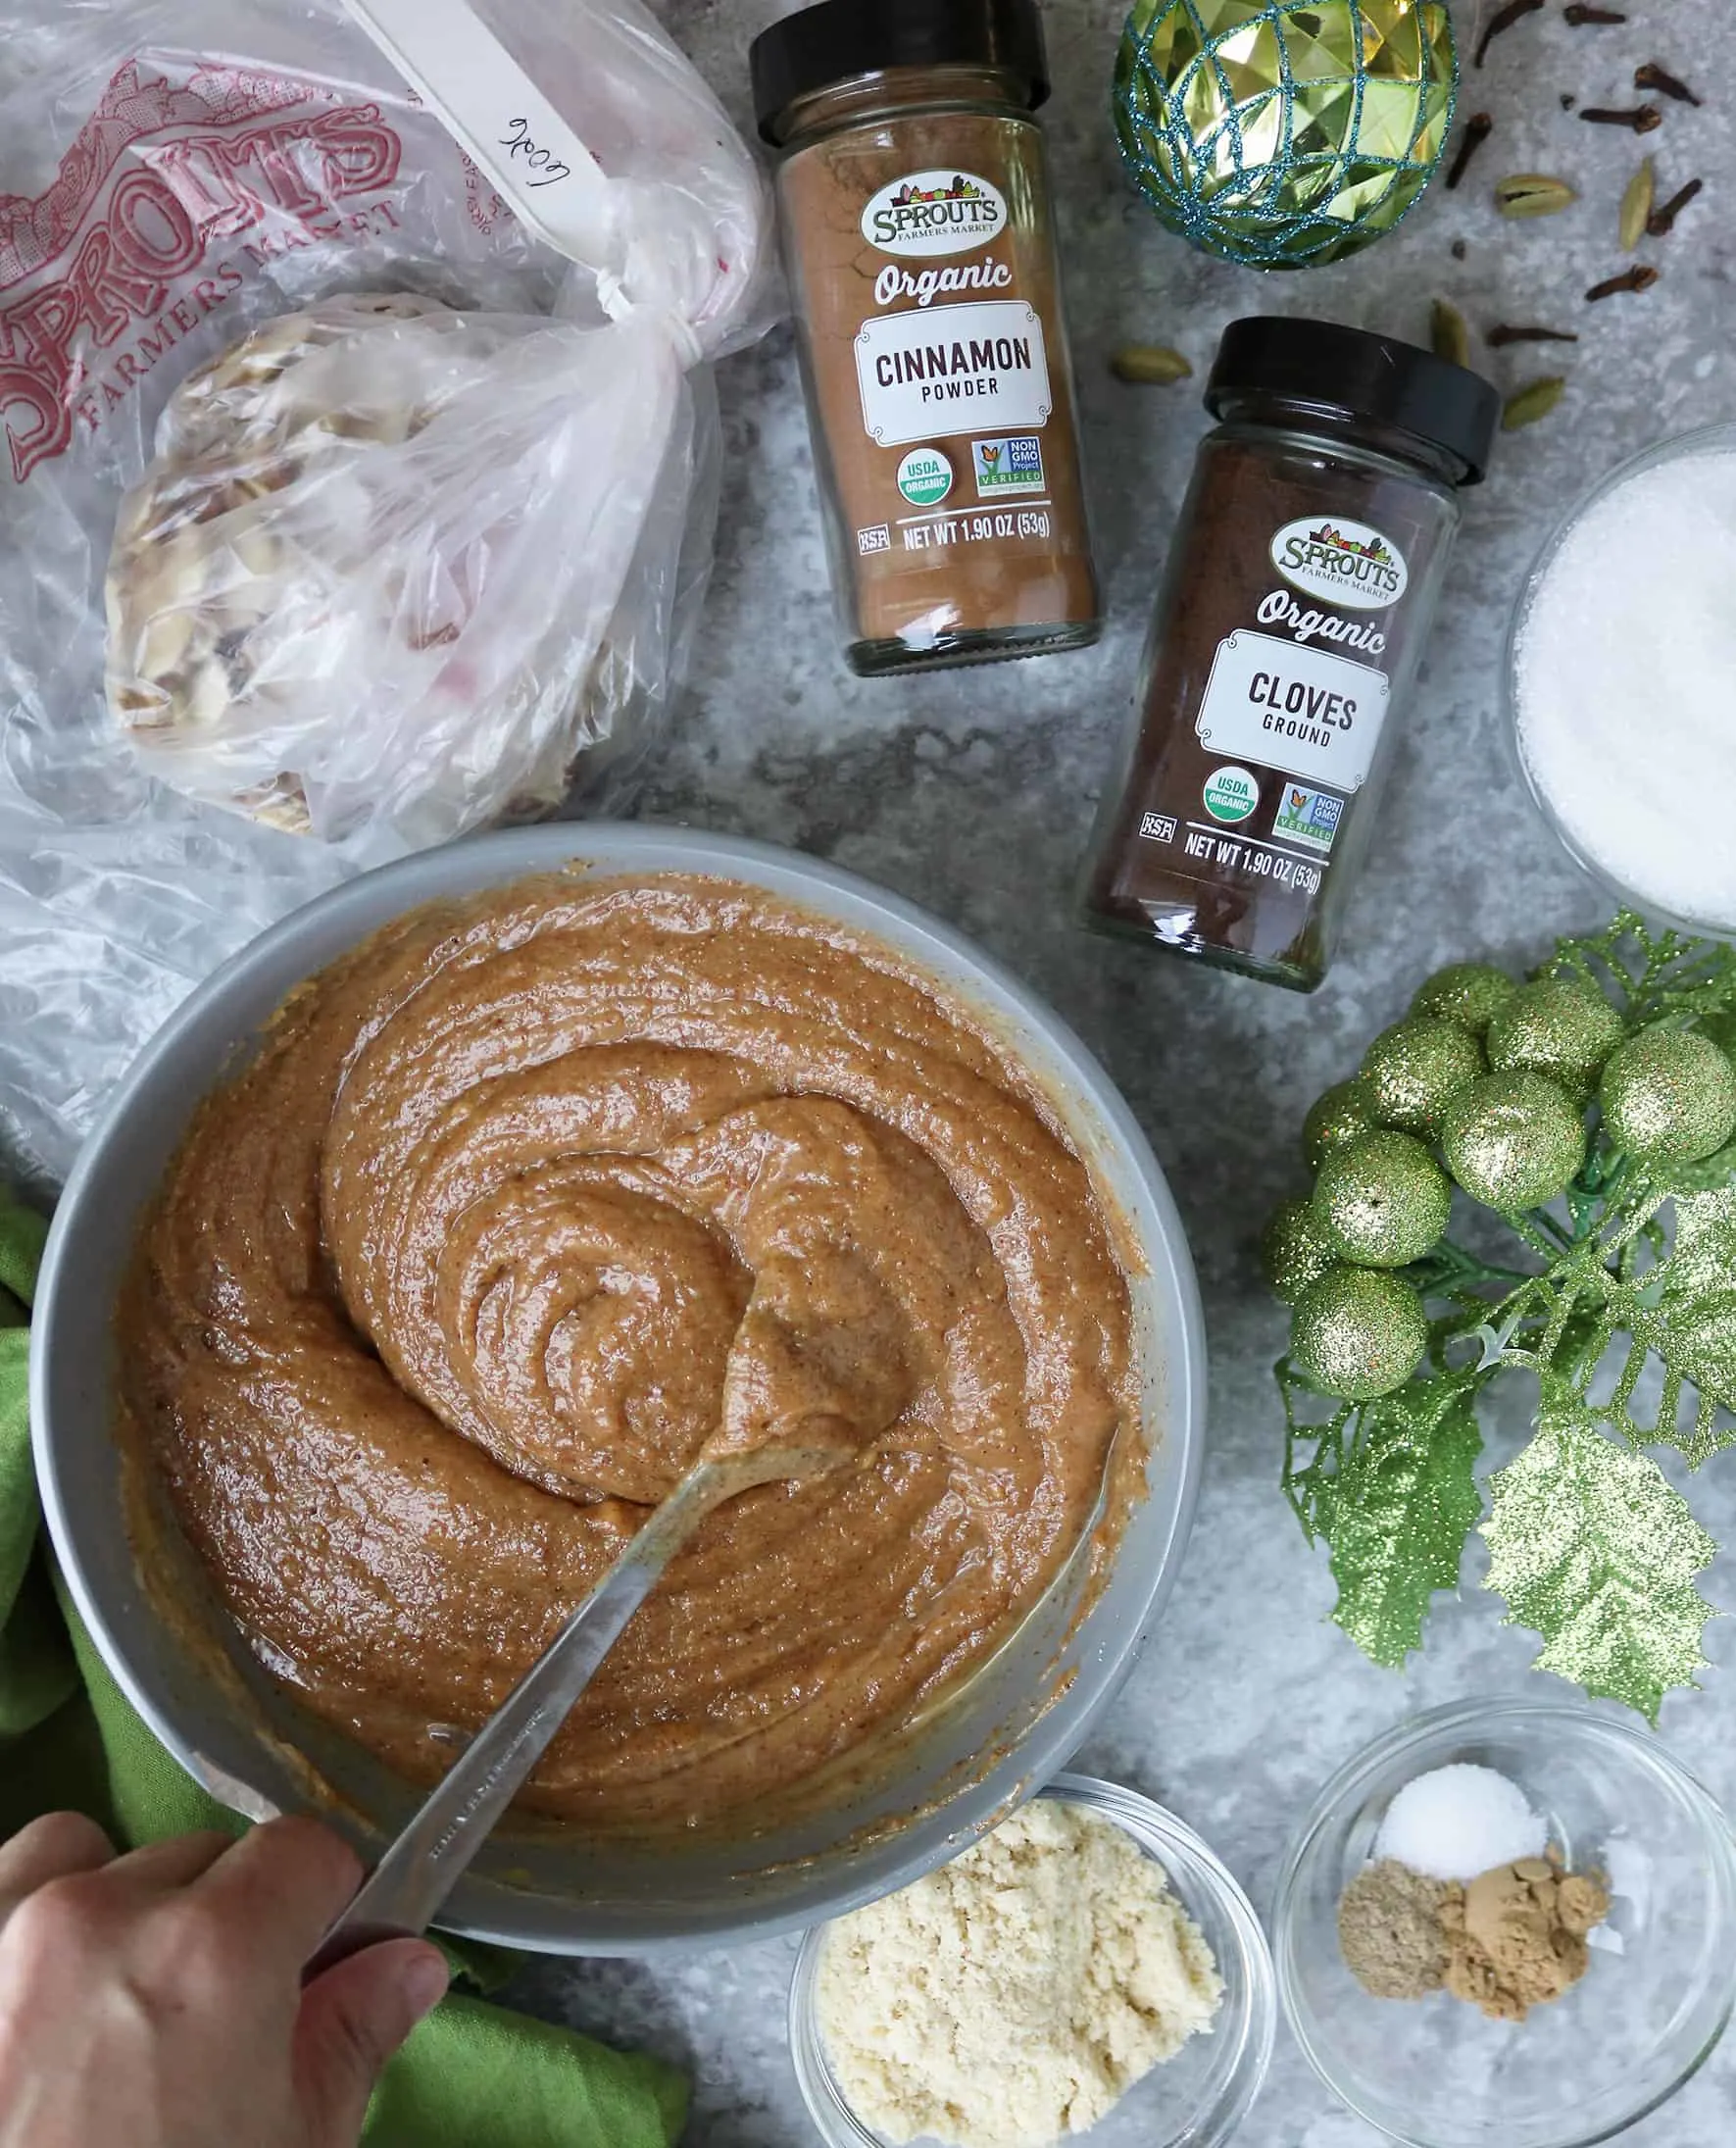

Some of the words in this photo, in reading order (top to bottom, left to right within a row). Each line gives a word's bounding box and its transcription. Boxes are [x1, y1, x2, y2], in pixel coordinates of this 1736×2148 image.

[872, 199, 999, 243] SPROUTS
[898, 227, 949, 241] FARMERS
[951, 223, 995, 235] MARKET
[874, 256, 1013, 306] Organic
[77, 261, 244, 431] FARMERS
[242, 200, 401, 267] MAET
[875, 337, 1032, 387] CINNAMON
[921, 377, 999, 403] POWDER
[1011, 440, 1036, 452] NON
[1012, 451, 1038, 462] GMO
[908, 460, 940, 477] USDA
[982, 472, 1041, 485] VERIFIED
[906, 476, 946, 493] ORGANIC
[903, 525, 930, 550] NET
[933, 521, 958, 546] WT
[961, 517, 993, 541] 1.90
[995, 514, 1016, 537] OZ
[1017, 511, 1051, 540] (53g)
[1278, 536, 1401, 592] SPROUTS
[1302, 566, 1350, 585] FARMERS
[1352, 580, 1391, 601] MARKET
[1257, 589, 1386, 654] Organic
[1248, 672, 1358, 730] CLOVES
[1263, 713, 1331, 747] GROUND
[1216, 775, 1249, 796] USDA
[1208, 792, 1250, 812] ORGANIC
[1314, 807, 1337, 822] GMO
[1316, 796, 1341, 812] NON
[1280, 818, 1331, 840] VERIFIED
[1184, 832, 1215, 859] NET
[1215, 840, 1242, 866] WT
[1243, 848, 1272, 875] 1.90
[1273, 858, 1293, 881] OZ
[1291, 864, 1322, 896] (53g)
